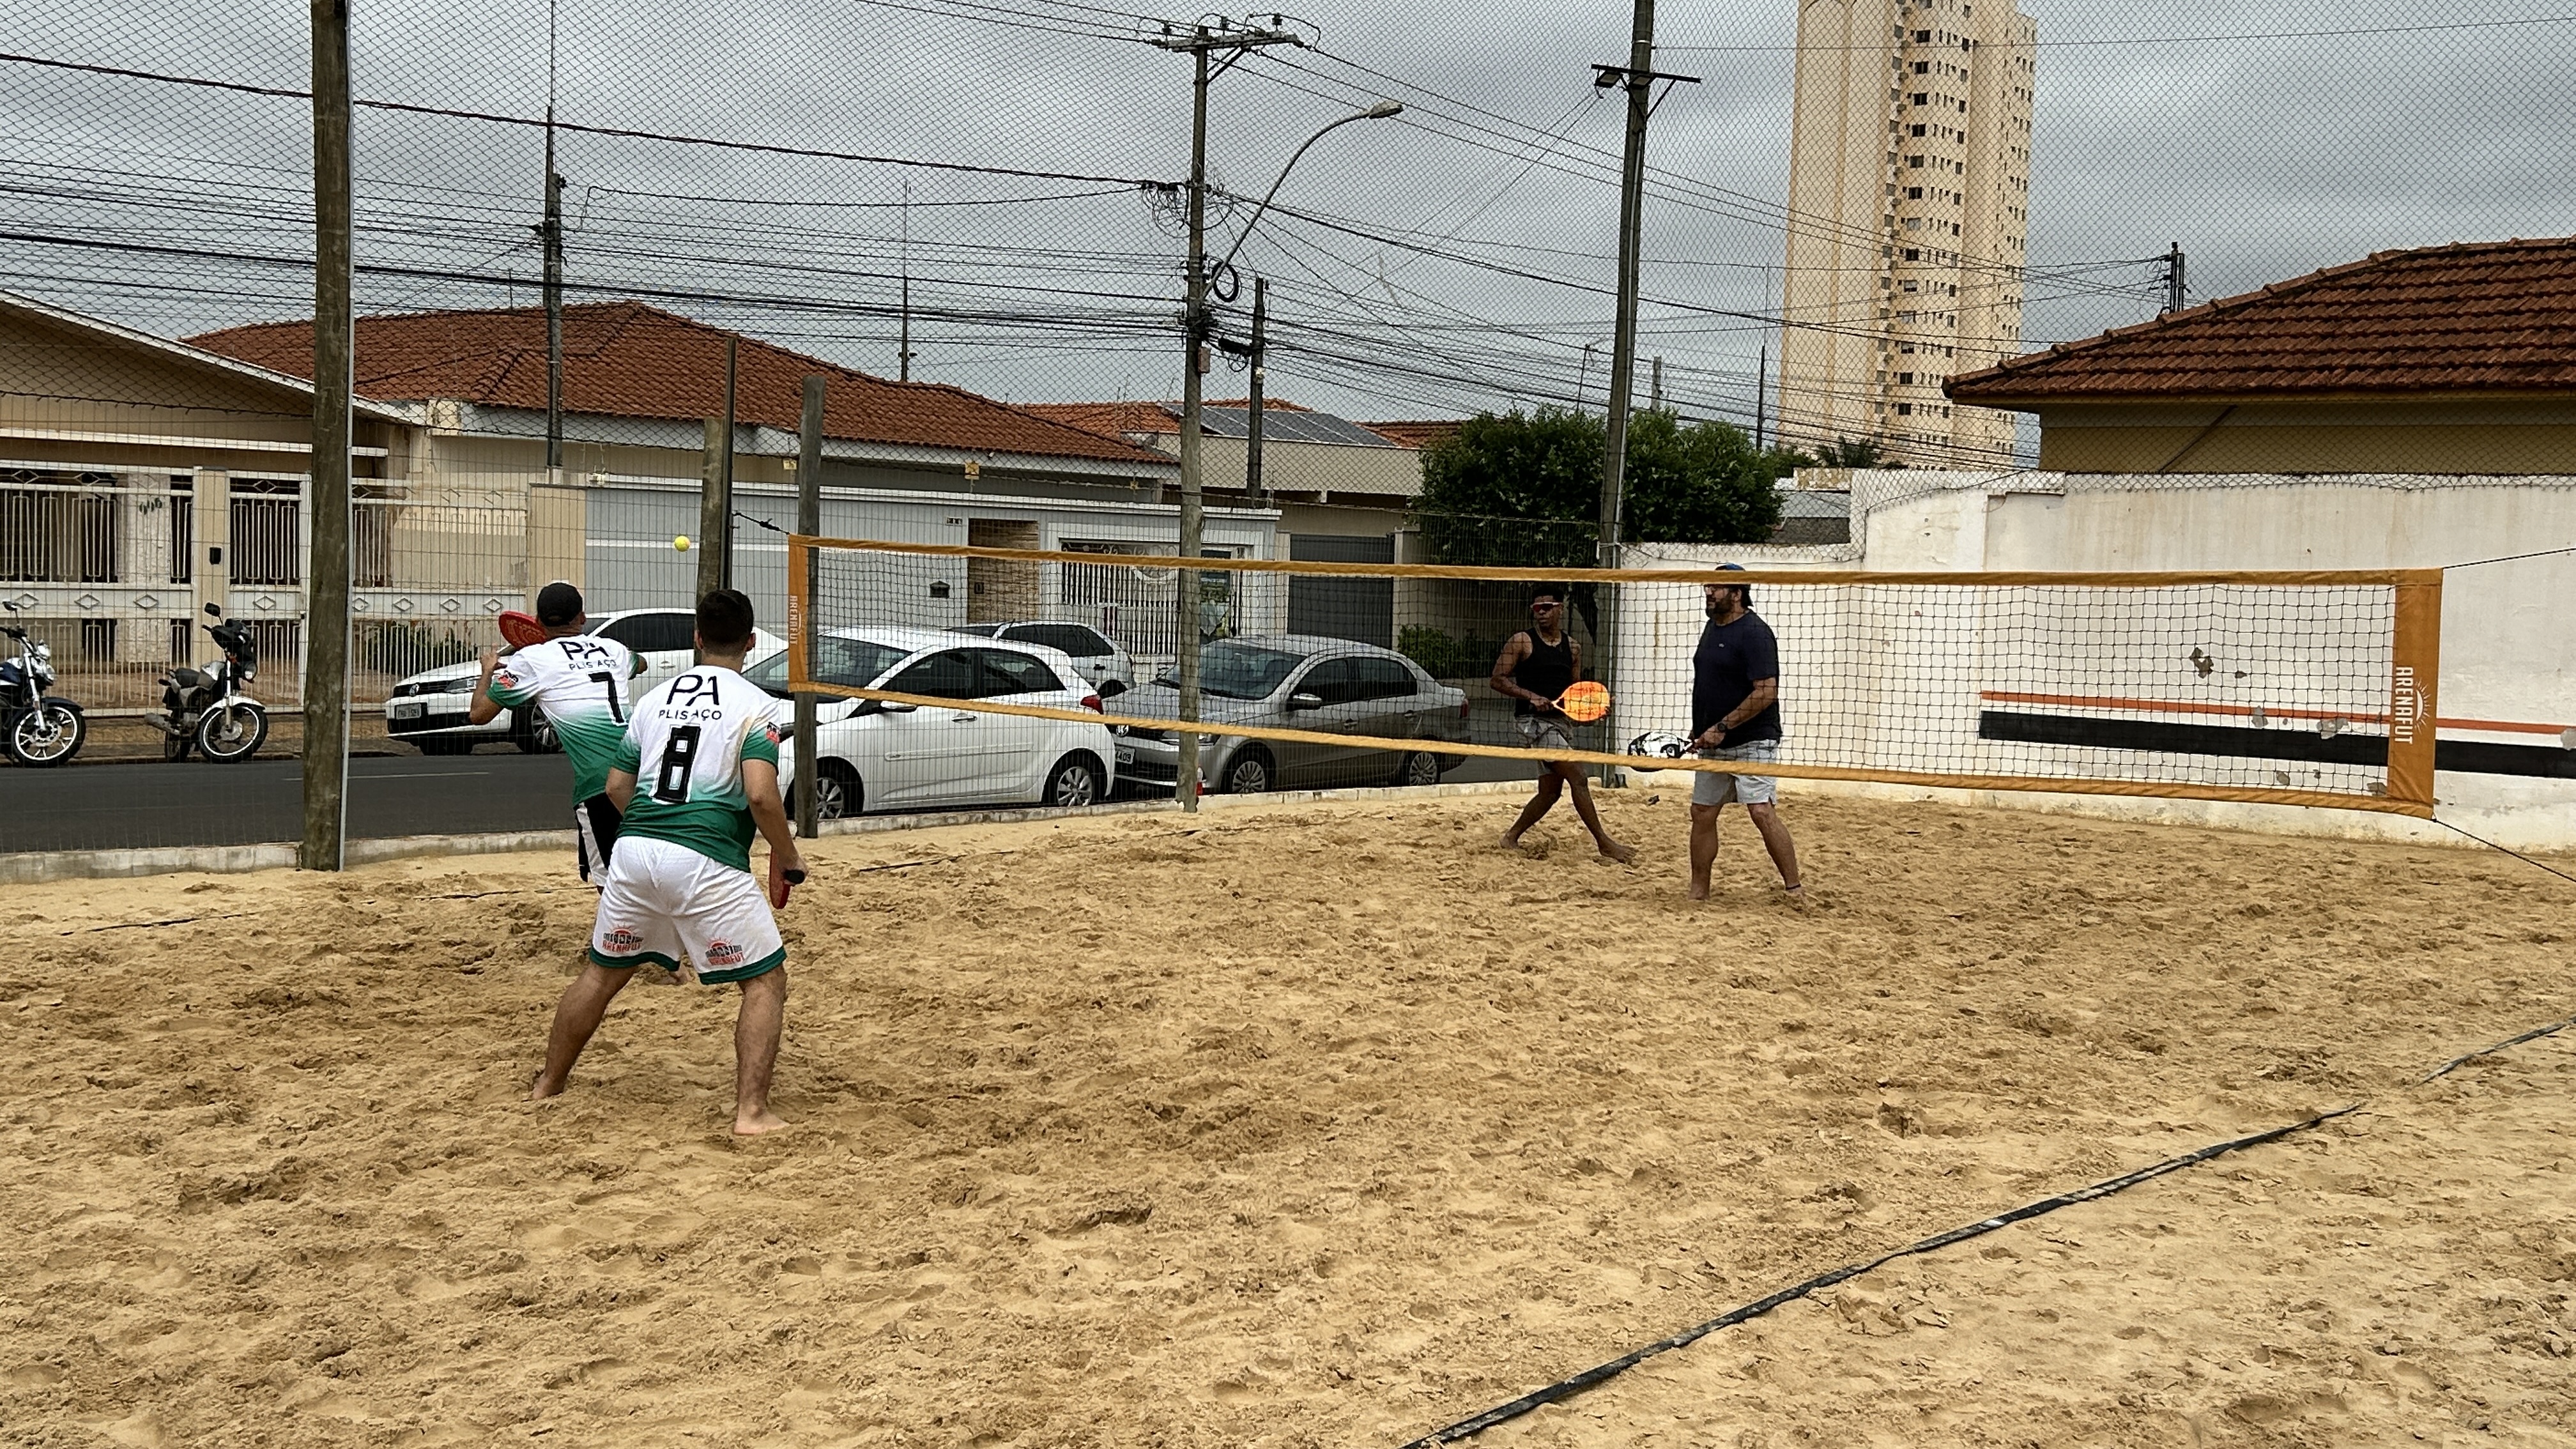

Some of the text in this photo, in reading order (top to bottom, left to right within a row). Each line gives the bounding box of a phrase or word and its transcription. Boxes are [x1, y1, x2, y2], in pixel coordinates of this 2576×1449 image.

[789, 595, 798, 645] ARENAFUT
[588, 671, 625, 724] 7
[659, 709, 722, 721] PLISAÇO
[666, 675, 719, 706] PA
[2395, 667, 2414, 745] ARENAFUT
[653, 725, 702, 804] 8
